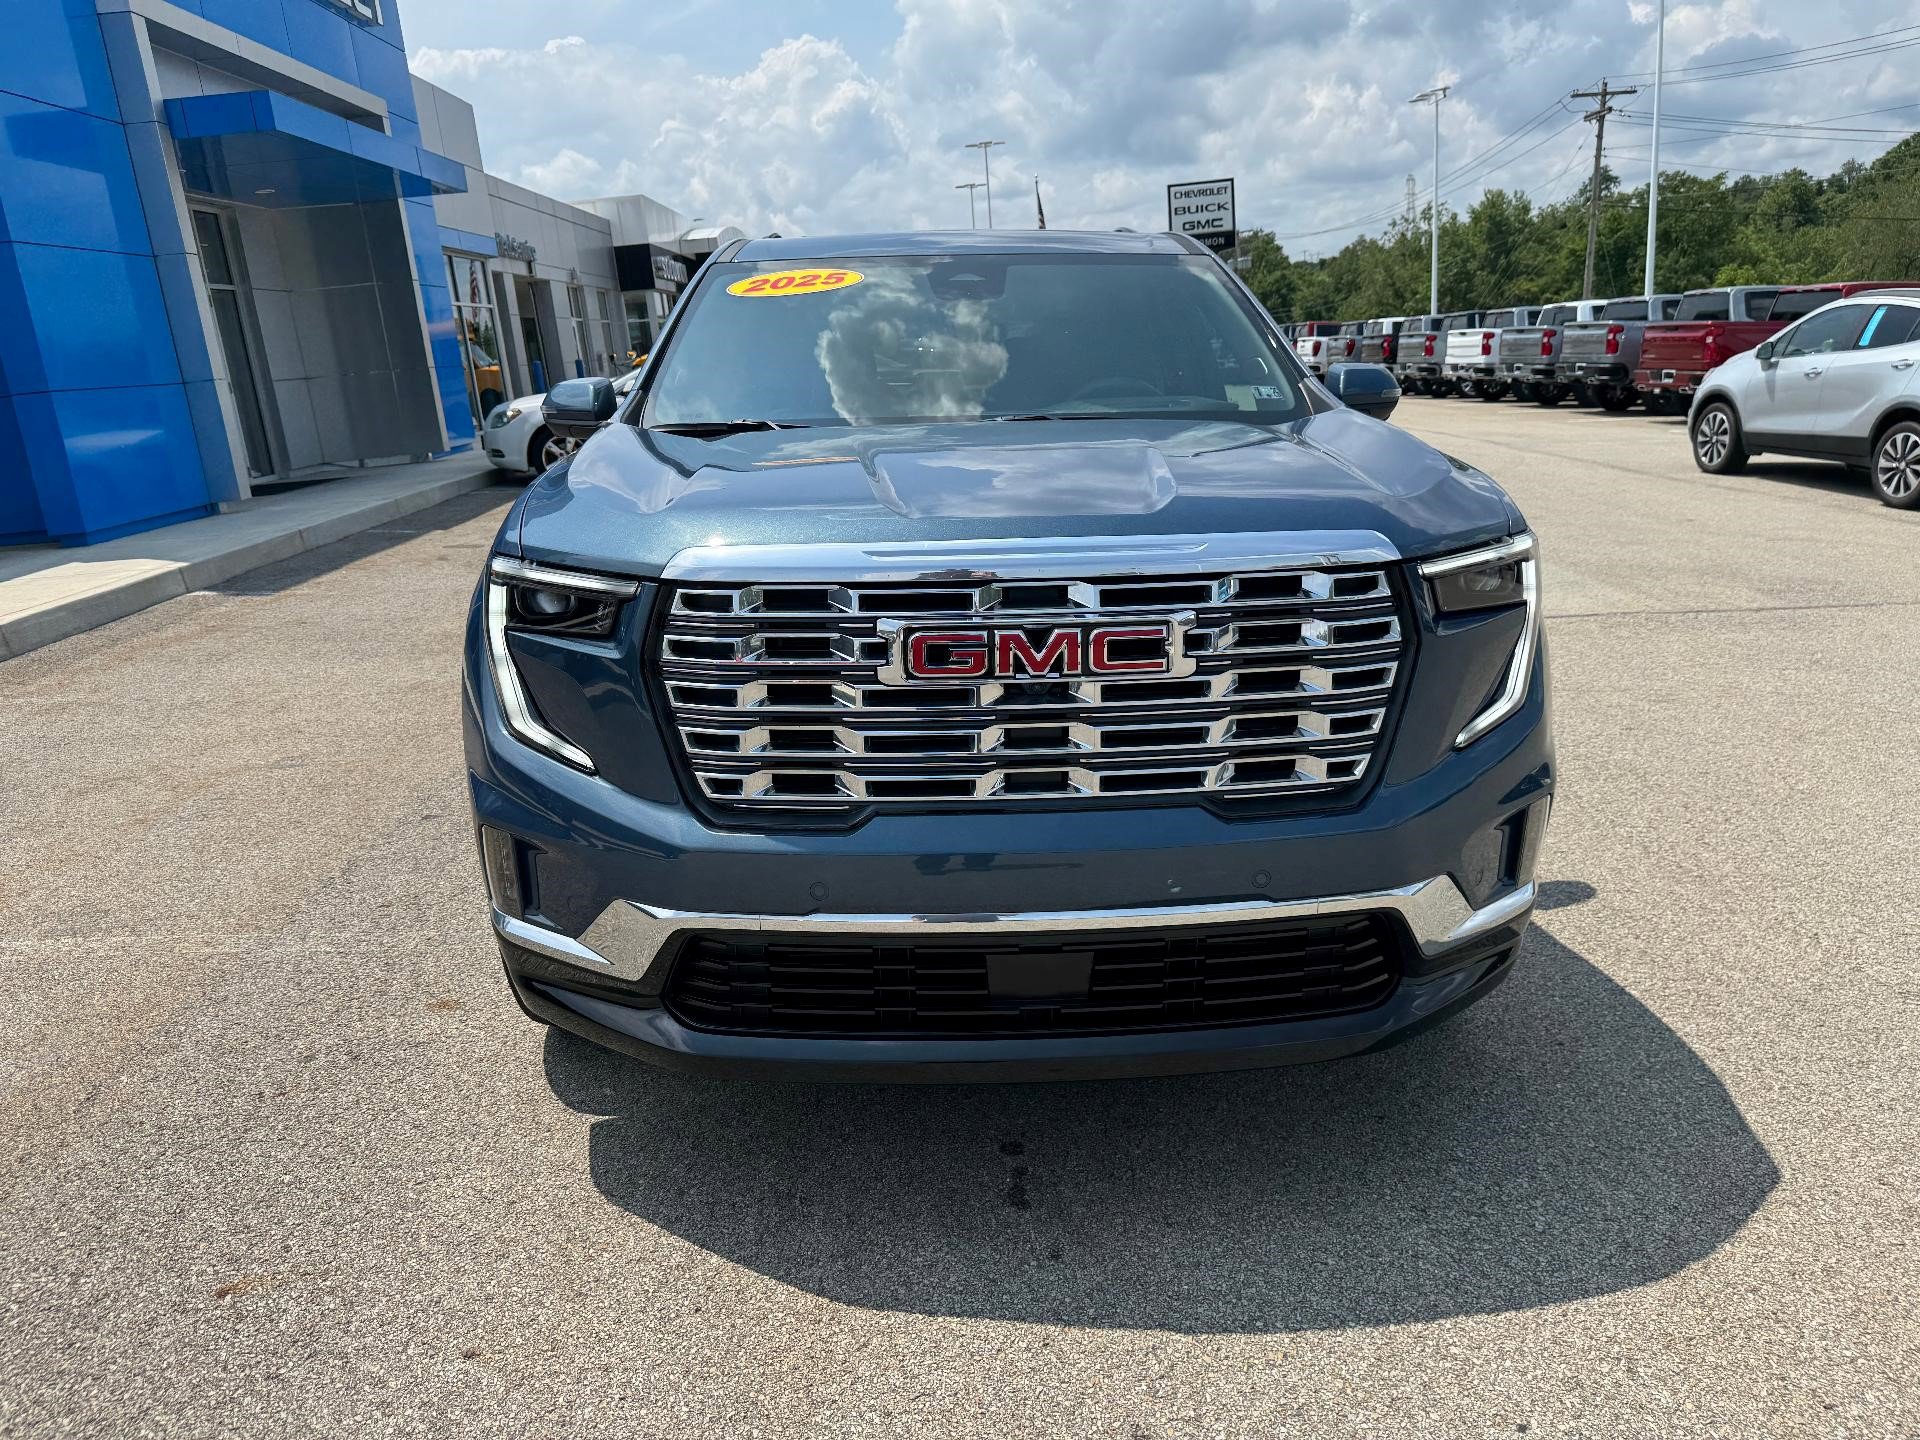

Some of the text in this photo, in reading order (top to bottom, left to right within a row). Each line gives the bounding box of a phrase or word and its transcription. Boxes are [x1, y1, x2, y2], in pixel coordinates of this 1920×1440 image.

[1174, 186, 1228, 200] CHEVROLET
[1174, 201, 1230, 216] BUICK
[1182, 217, 1224, 232] GMC
[741, 272, 848, 293] 2025
[908, 625, 1169, 678] GMC
